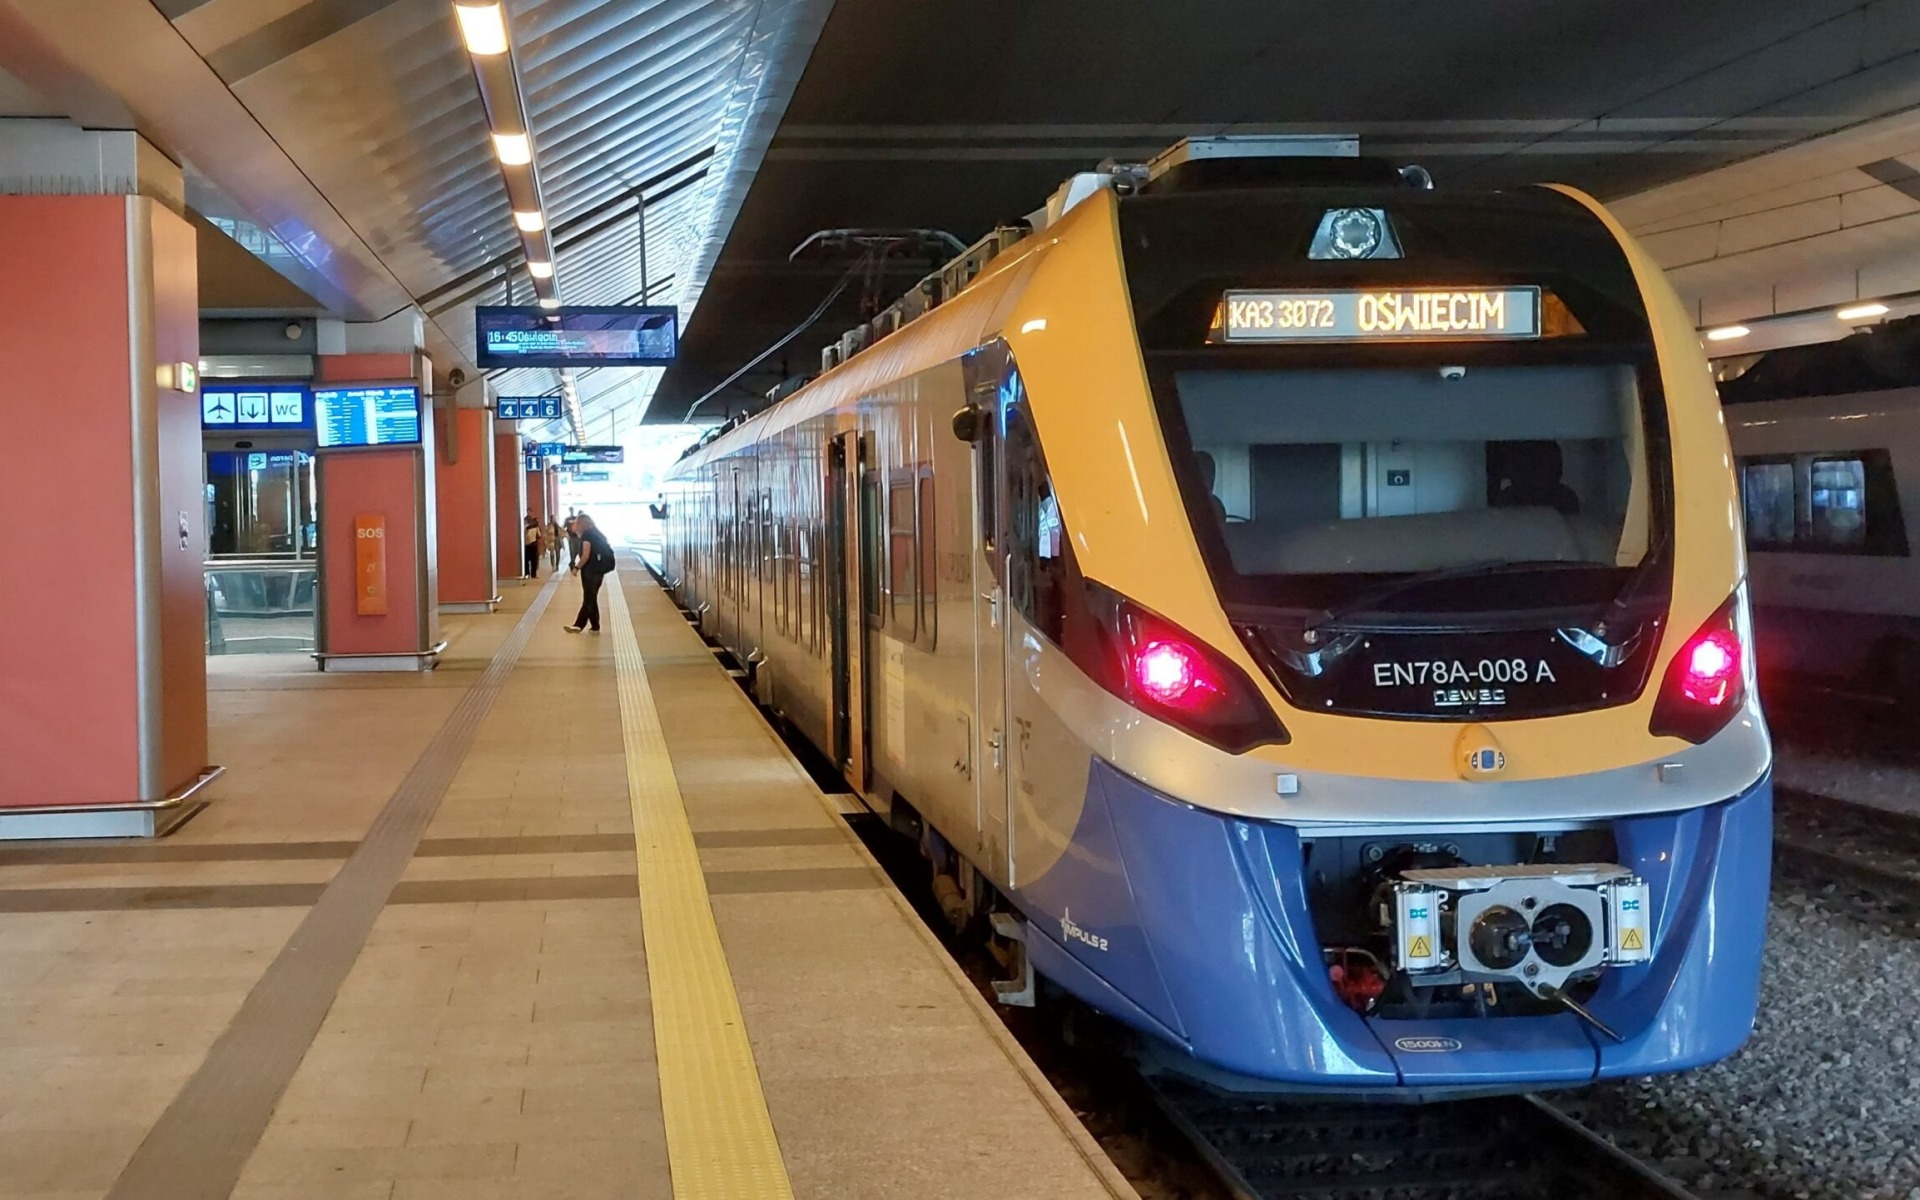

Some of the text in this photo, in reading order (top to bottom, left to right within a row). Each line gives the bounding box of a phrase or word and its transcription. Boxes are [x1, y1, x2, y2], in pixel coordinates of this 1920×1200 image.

[1230, 292, 1504, 331] KA3 3072 OŚWIĘCIM
[275, 404, 298, 416] WC
[504, 405, 514, 416] 4
[525, 405, 535, 416] 4
[546, 405, 554, 416] 6
[357, 527, 384, 539] SOS
[1374, 659, 1556, 686] EN78A-008 A
